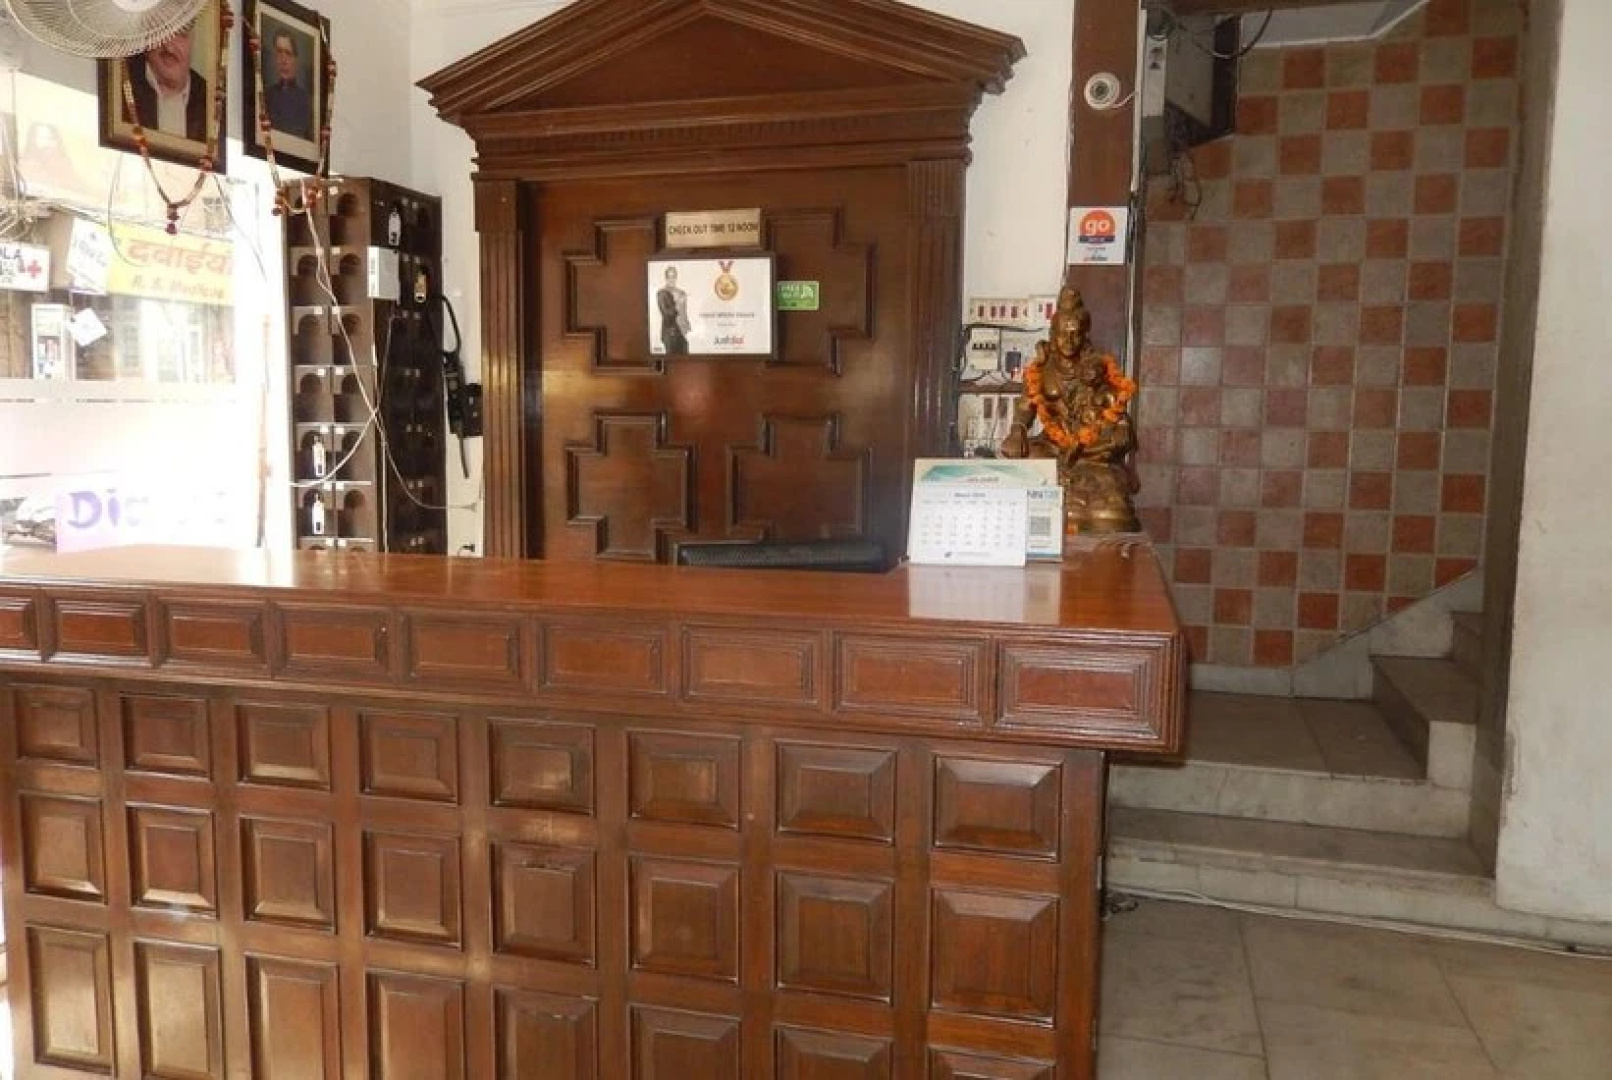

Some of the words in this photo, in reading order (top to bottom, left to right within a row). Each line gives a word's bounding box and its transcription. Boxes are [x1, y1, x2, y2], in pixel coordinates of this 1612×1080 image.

[669, 225, 692, 235] CHECK
[693, 223, 708, 235] OUT
[710, 223, 725, 234] TIME
[736, 221, 759, 233] NOON
[1085, 218, 1110, 235] go
